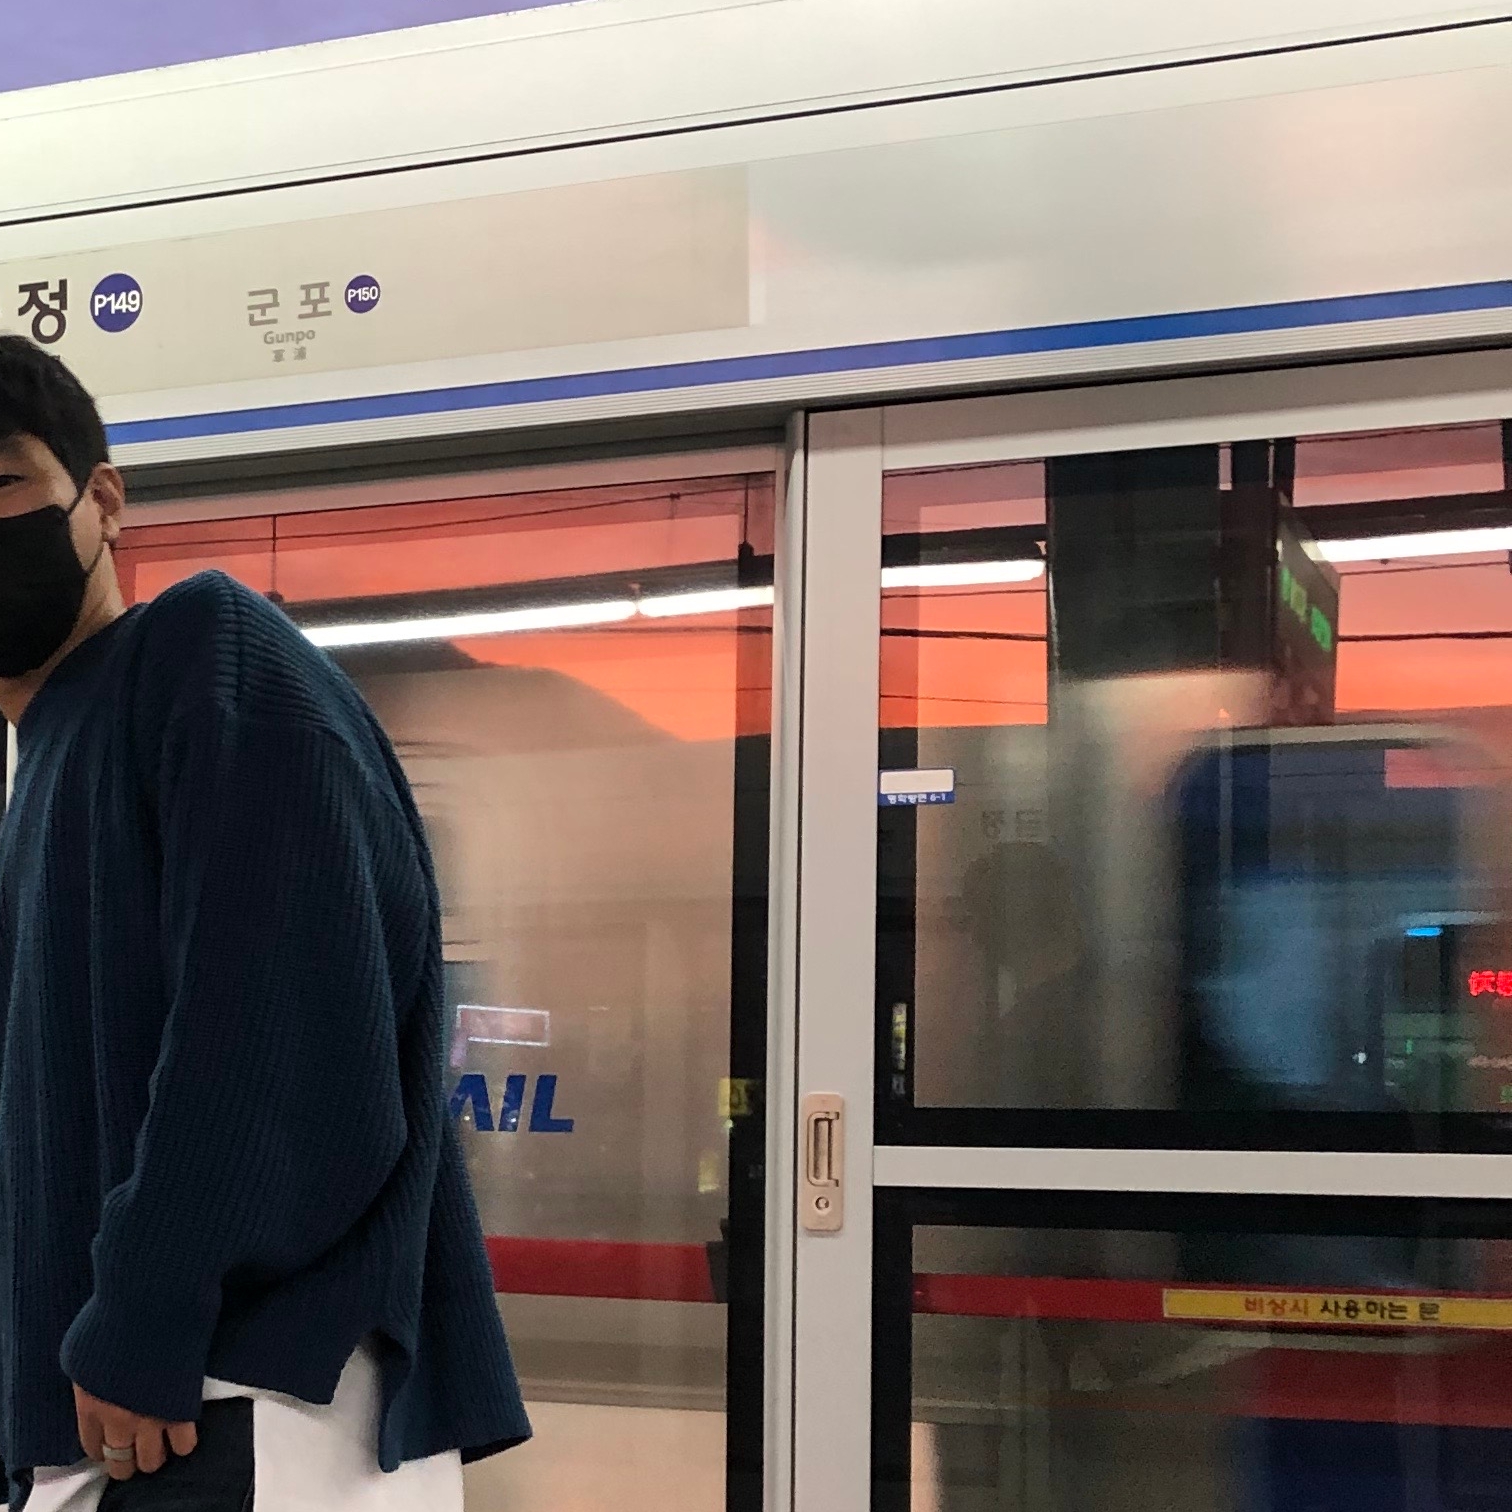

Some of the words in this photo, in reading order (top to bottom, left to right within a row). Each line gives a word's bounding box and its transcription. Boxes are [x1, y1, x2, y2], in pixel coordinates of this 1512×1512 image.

[93, 289, 139, 317] P149
[246, 281, 333, 327] 군포
[347, 285, 379, 303] P150
[263, 329, 316, 345] Gunpo
[450, 1074, 574, 1133] AIL
[1243, 1296, 1310, 1316] 비상시
[1320, 1299, 1408, 1320] 사용하는
